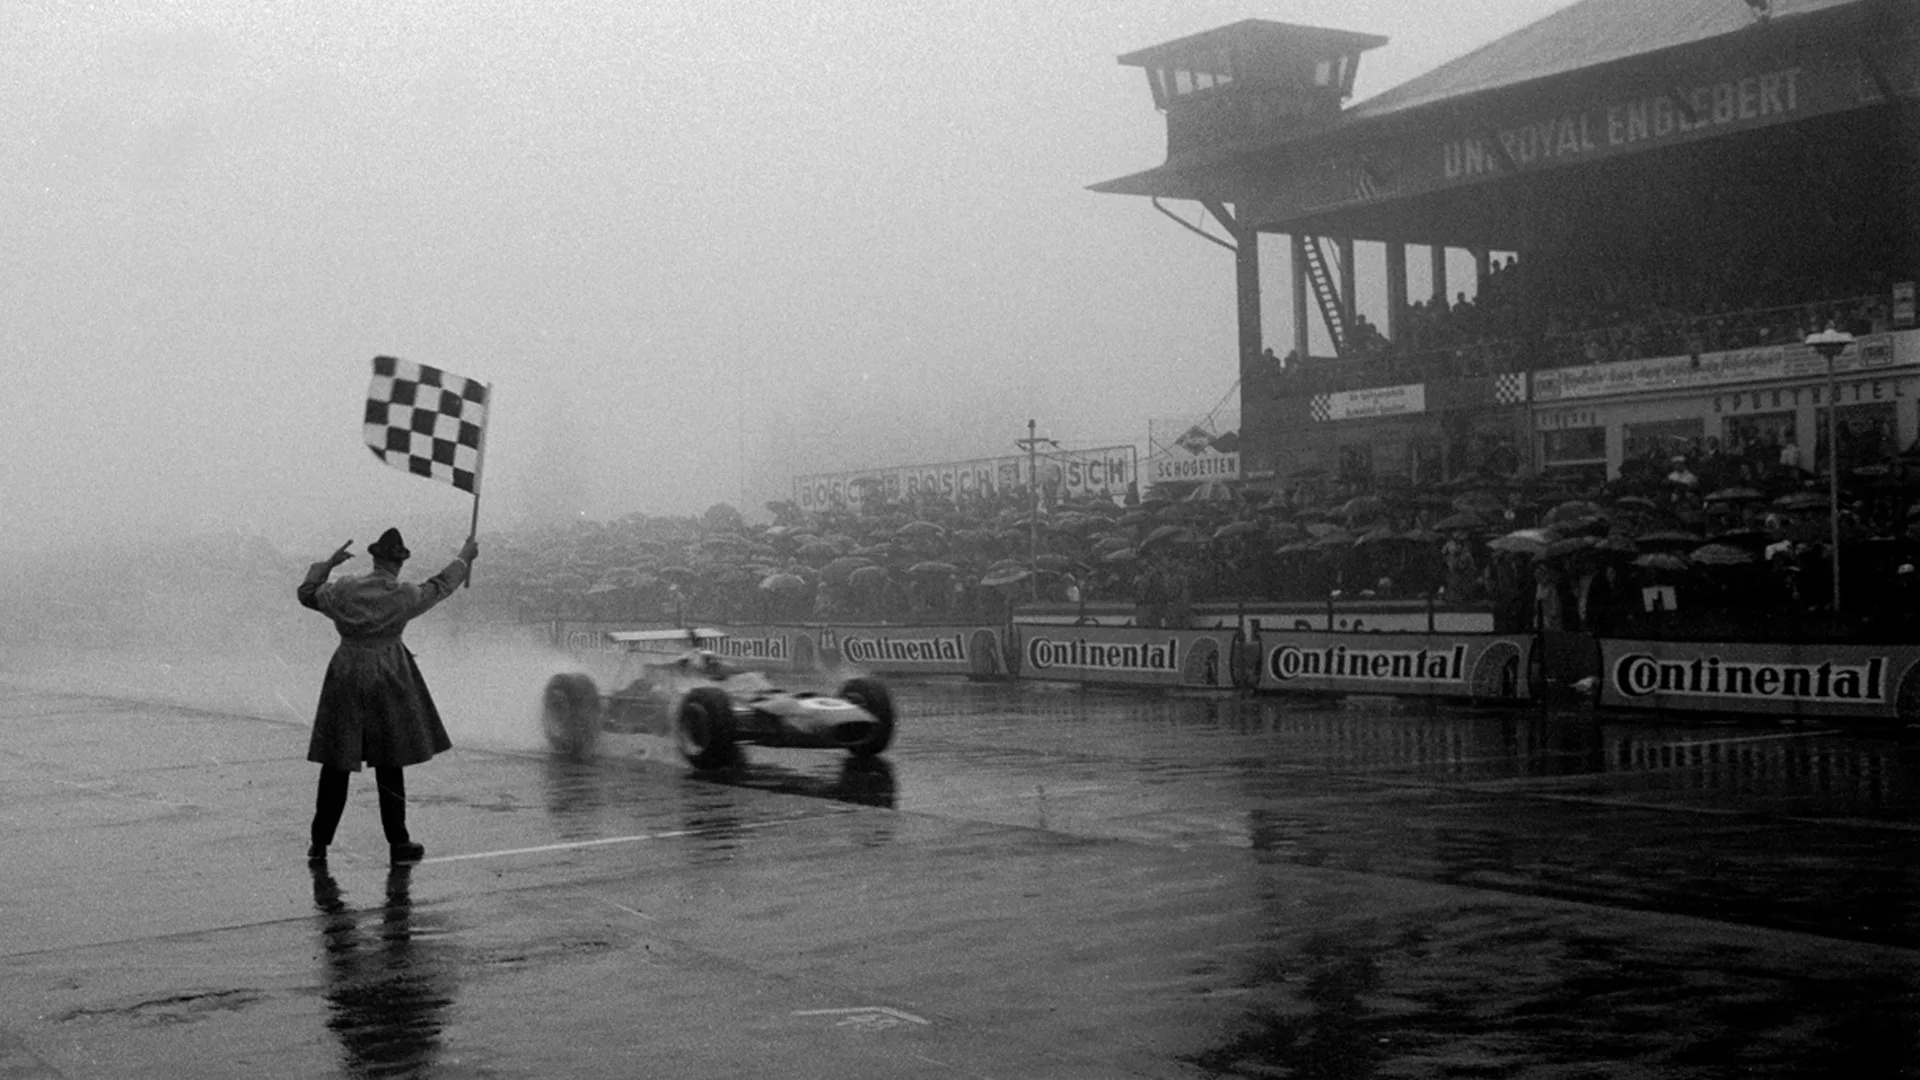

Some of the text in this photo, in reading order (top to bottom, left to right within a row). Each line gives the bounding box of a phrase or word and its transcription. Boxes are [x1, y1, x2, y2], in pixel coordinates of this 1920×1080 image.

[1607, 67, 1802, 146] ENGLEBERT
[843, 634, 965, 664] Continental
[1029, 637, 1177, 670] Continental
[1267, 645, 1466, 682] Continental
[1615, 654, 1885, 699] Continental
